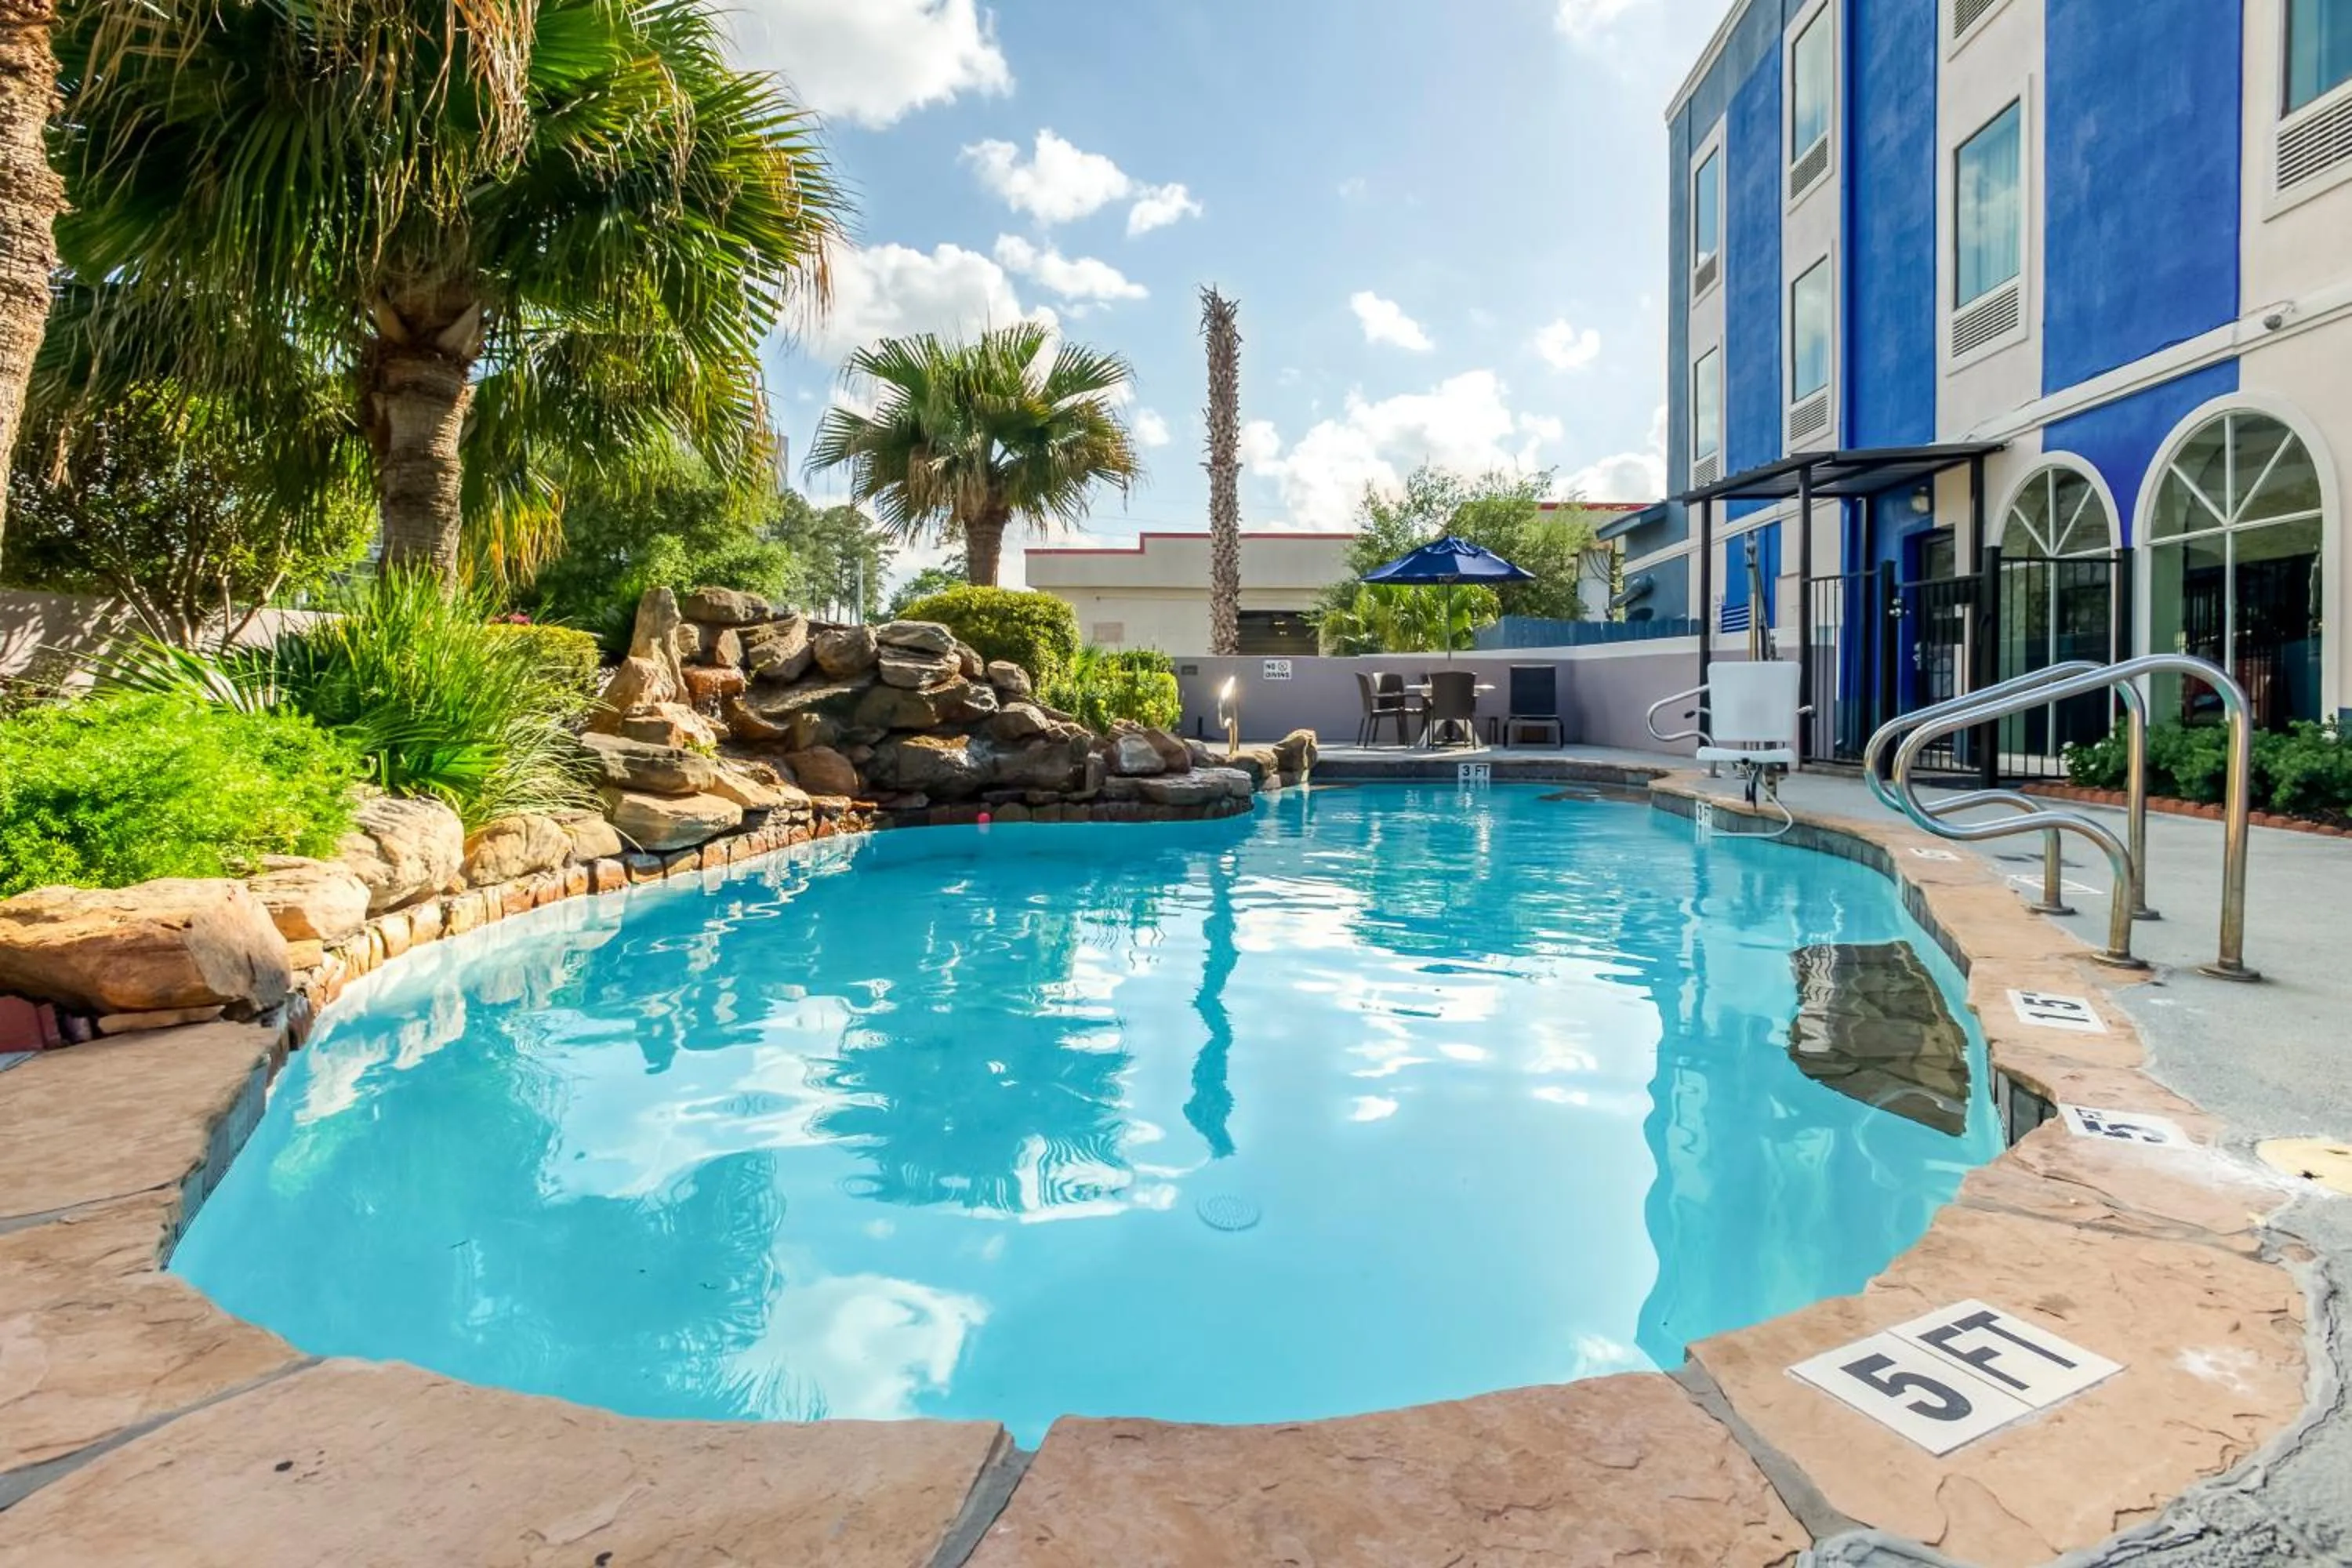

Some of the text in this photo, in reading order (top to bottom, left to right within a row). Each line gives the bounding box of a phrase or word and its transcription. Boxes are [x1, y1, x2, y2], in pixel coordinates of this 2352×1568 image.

[1462, 765, 1488, 776] 3 FT
[1840, 1310, 2078, 1421] 5 FT
